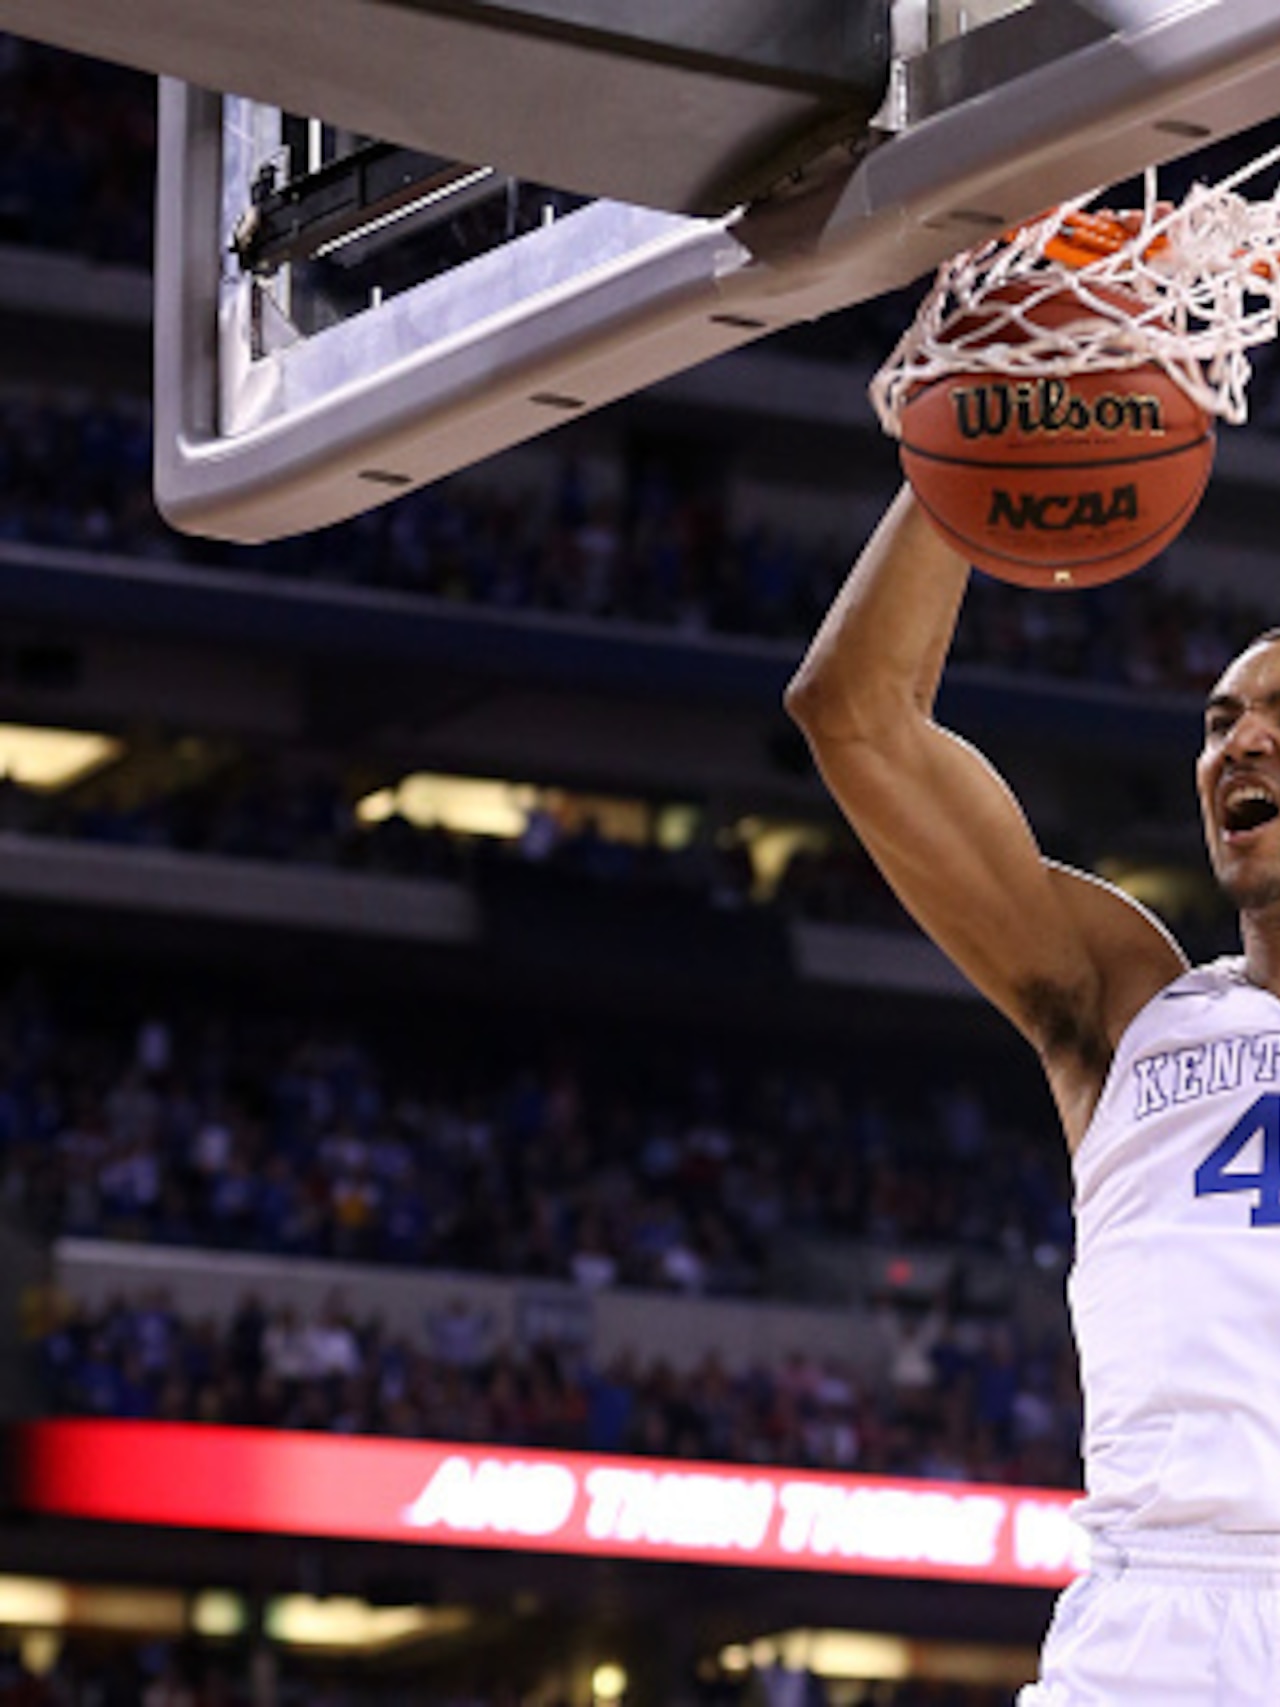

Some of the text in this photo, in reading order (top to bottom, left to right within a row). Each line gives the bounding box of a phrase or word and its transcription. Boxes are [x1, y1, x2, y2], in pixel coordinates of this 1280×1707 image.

[952, 378, 1164, 439] Wilson
[987, 483, 1137, 530] NCAA
[405, 1456, 577, 1536] AND
[585, 1467, 776, 1549] THEN
